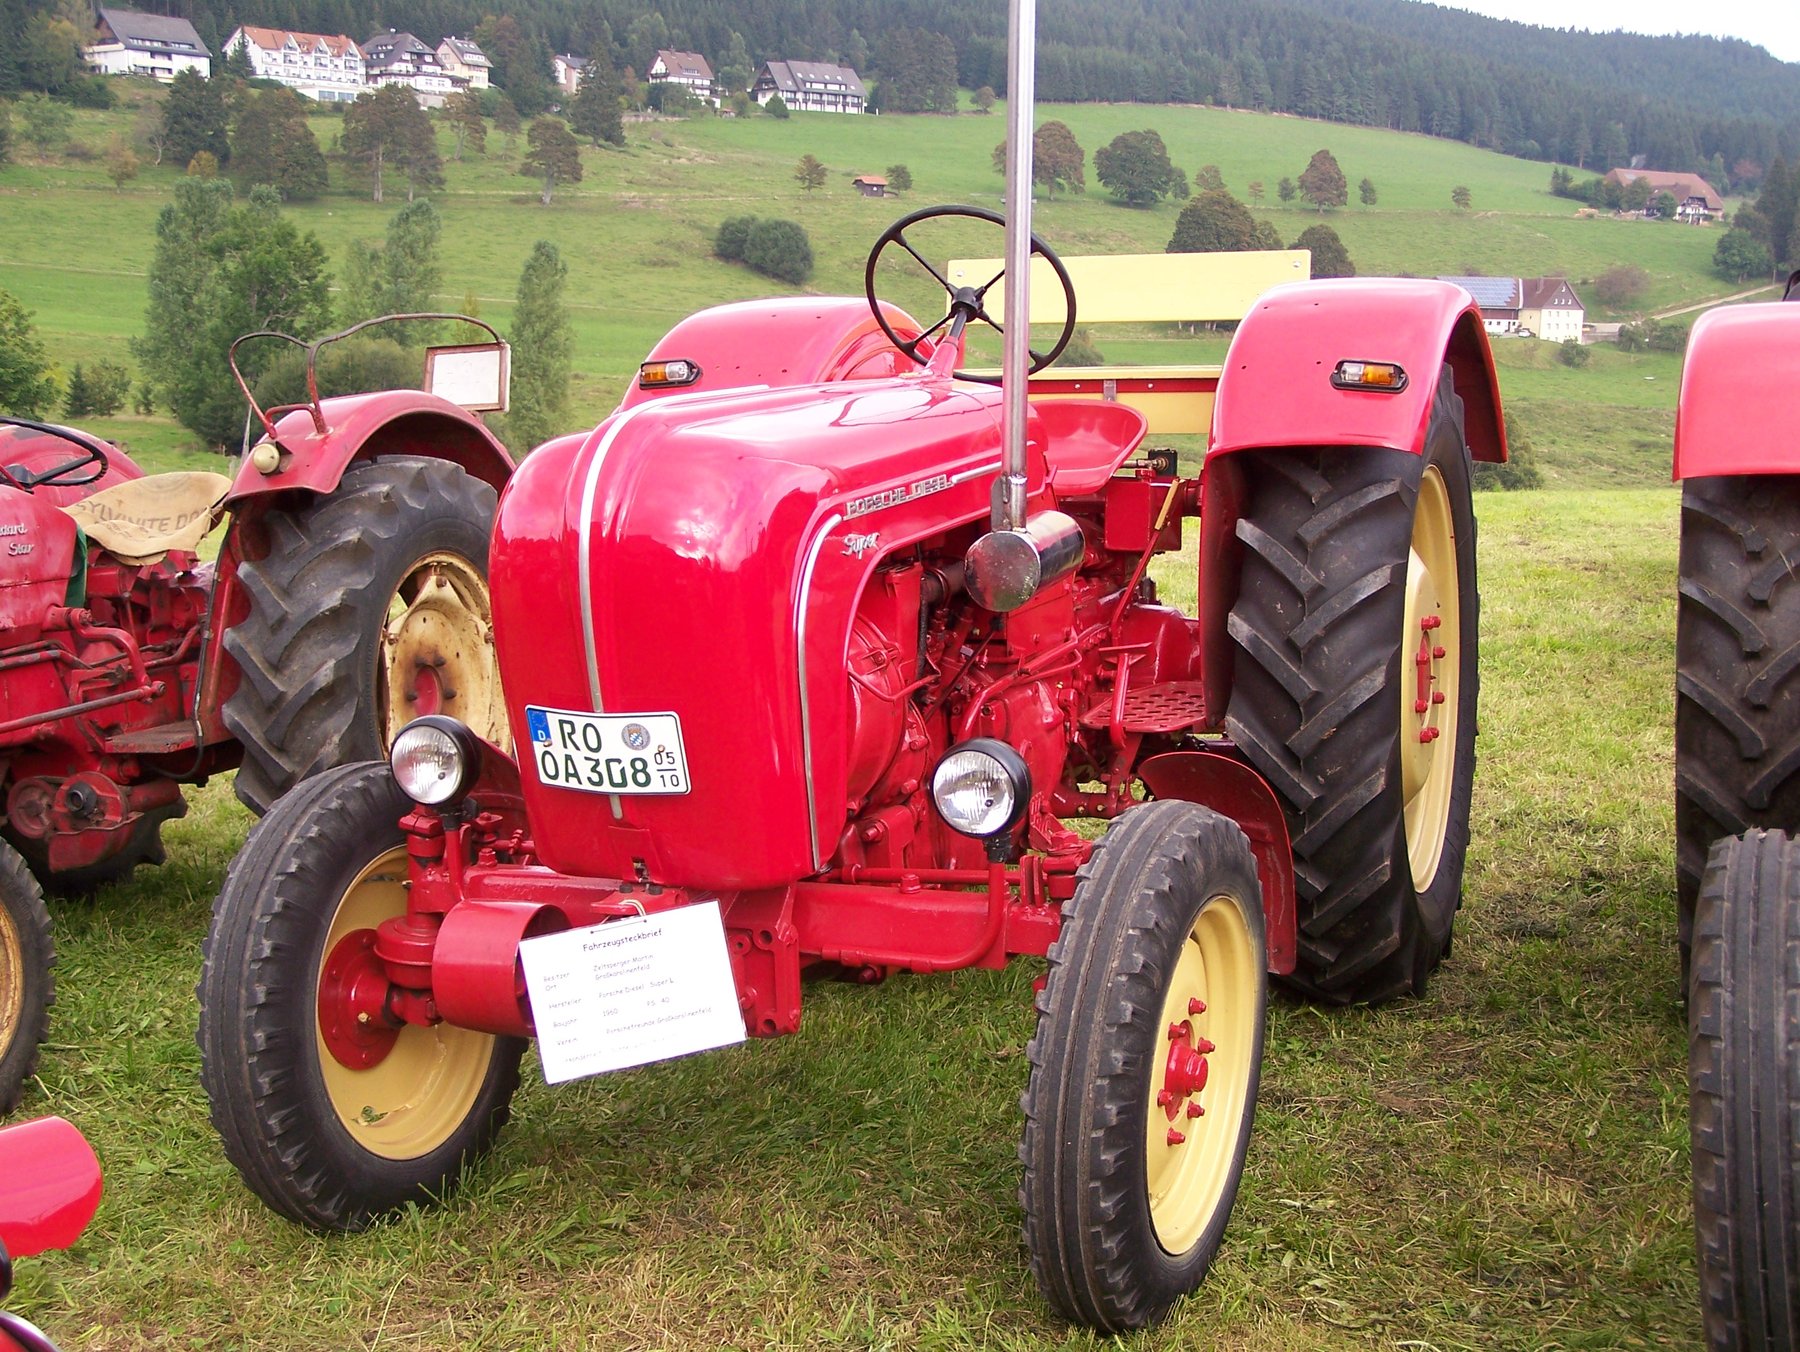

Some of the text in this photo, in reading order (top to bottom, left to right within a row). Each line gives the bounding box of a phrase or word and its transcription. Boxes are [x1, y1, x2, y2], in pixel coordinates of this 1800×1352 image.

[844, 473, 954, 520] PORSCHE DIESEL
[841, 532, 880, 560] Super
[537, 730, 546, 741] D
[558, 718, 602, 753] RO
[654, 751, 675, 765] 05
[659, 774, 680, 788] 10
[582, 928, 663, 952] Fahrzeugsteckbrief
